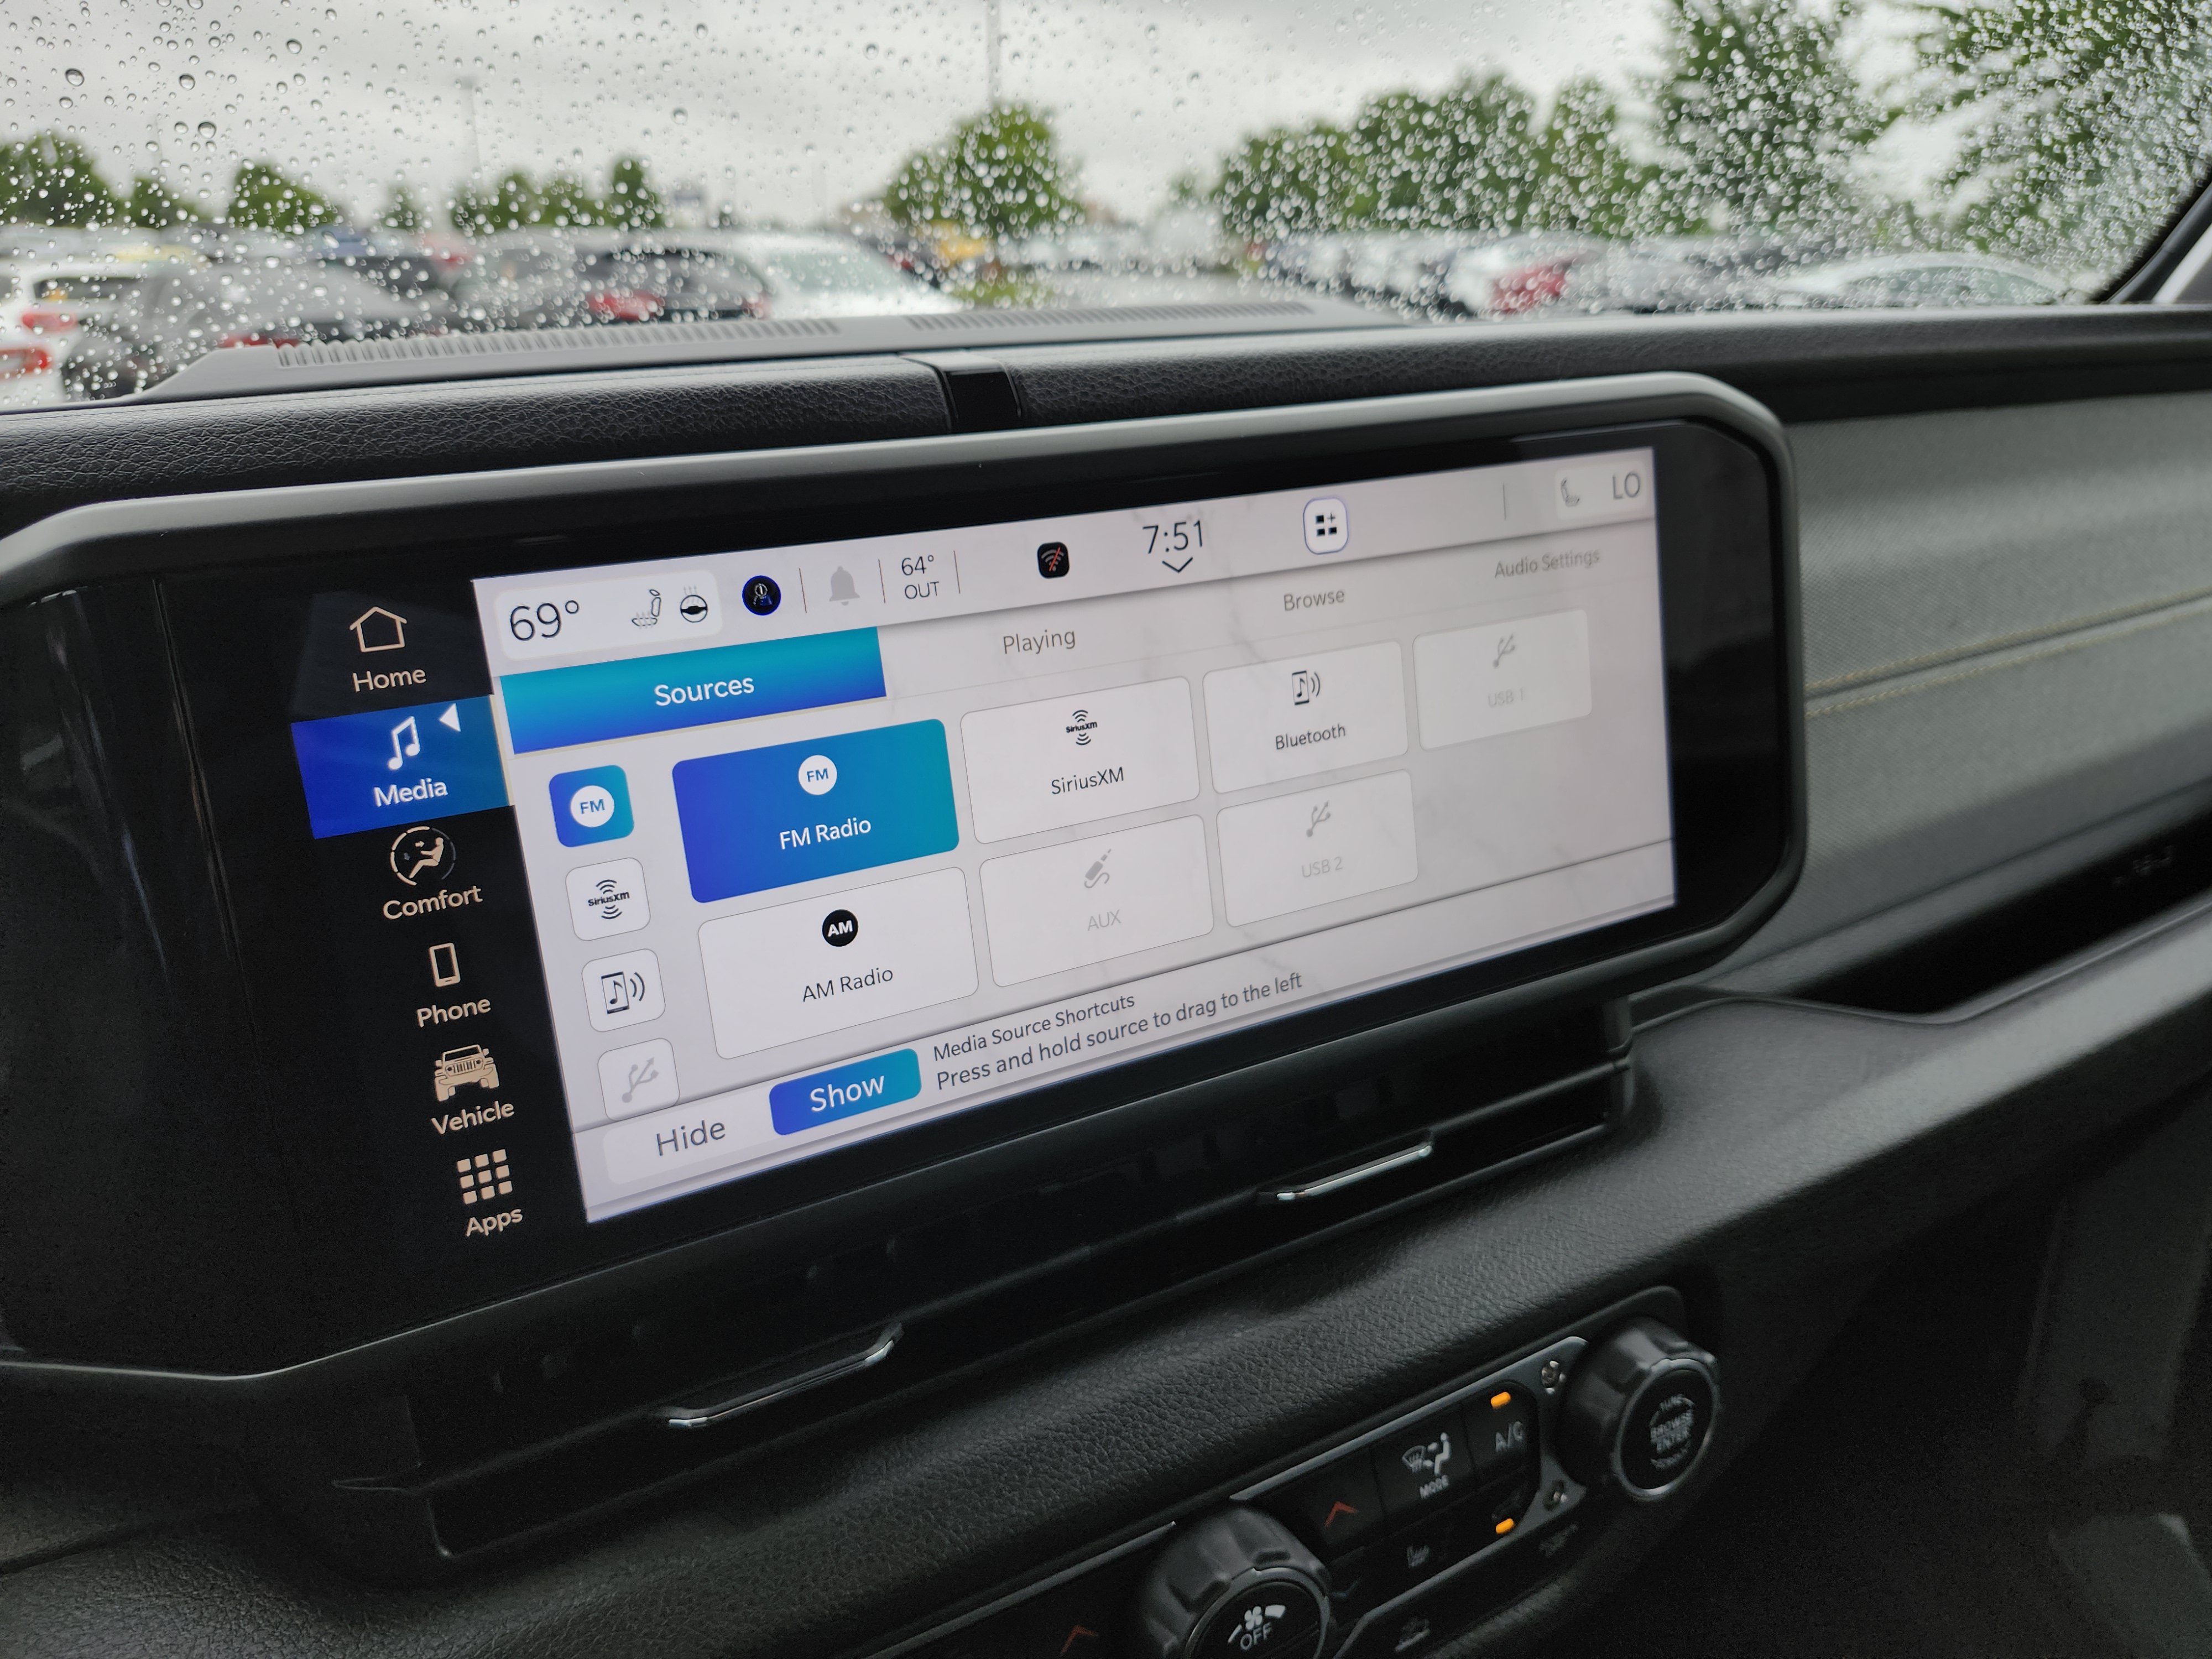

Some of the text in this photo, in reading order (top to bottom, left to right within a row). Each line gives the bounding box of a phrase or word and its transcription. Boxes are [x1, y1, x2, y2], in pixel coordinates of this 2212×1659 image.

[1613, 471, 1641, 499] LO
[1142, 520, 1203, 554] 7:51
[901, 555, 935, 576] 64°
[1494, 549, 1600, 578] Audio Settings
[904, 581, 940, 599] OUT
[1283, 588, 1345, 612] Browse
[509, 599, 580, 641] 69°
[1003, 629, 1076, 655] Playing
[352, 667, 427, 693] Home
[654, 675, 755, 706] Sources
[1488, 689, 1514, 708] USB
[1275, 723, 1346, 750] Bluetooth
[806, 768, 830, 783] FM
[1051, 766, 1124, 795] SiriusXM
[373, 779, 448, 807] Media
[580, 799, 606, 815] FM
[779, 817, 872, 850] FM Radio
[1301, 857, 1343, 878] USB 2
[382, 885, 483, 920] Comfort
[827, 920, 853, 937] AM
[1087, 908, 1122, 931] AUX
[802, 967, 894, 1003] AM Radio
[416, 999, 492, 1027] Phone
[933, 995, 1135, 1061] Media Source Shortcuts
[937, 972, 1302, 1090] Press and hold source to drag to the left
[810, 1075, 885, 1113] Show
[430, 1101, 515, 1134] Vehicle
[656, 1120, 726, 1156] Hide
[465, 1207, 523, 1237] Apps
[1240, 1621, 1271, 1650] OFF
